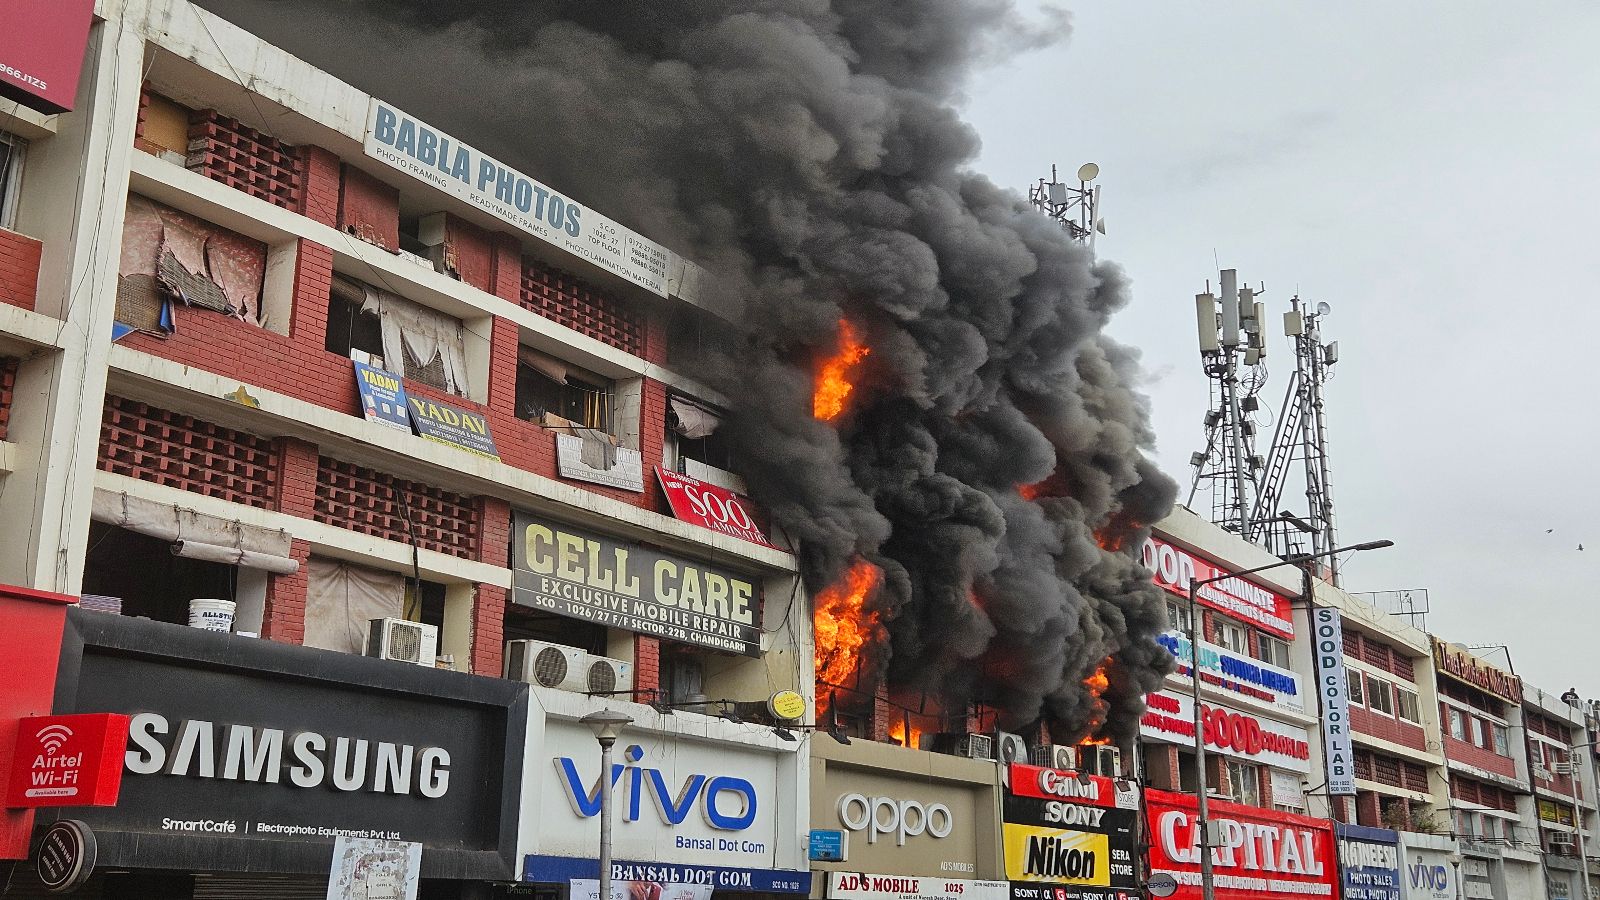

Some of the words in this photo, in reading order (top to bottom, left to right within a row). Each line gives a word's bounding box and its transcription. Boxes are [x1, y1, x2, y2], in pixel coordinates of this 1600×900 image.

[374, 104, 471, 186] BABLA
[477, 156, 582, 239] PHOTOS
[376, 147, 407, 168] PHOTO
[408, 163, 448, 189] FRAMING
[469, 192, 518, 222] READYMADE
[517, 218, 549, 238] FRAMES
[588, 234, 600, 245] TOP
[601, 242, 621, 257] FLOOR
[566, 240, 590, 258] PHOTO
[590, 250, 632, 278] LAMINATION
[632, 272, 663, 293] MATERIAL
[360, 368, 399, 393] YADAV
[408, 398, 487, 436] YADAV
[666, 480, 683, 489] NEW
[525, 524, 640, 598] CELL
[654, 559, 753, 625] CARE
[1142, 537, 1195, 590] OOD
[1211, 567, 1276, 613] LAMINATE
[536, 596, 556, 610] SCO
[567, 602, 609, 622] 1026/27
[612, 615, 629, 628] F/F
[632, 619, 688, 642] SECTOR-22B,
[690, 632, 746, 652] CHANDIGARH
[541, 578, 628, 613] EXCLUSIVE
[633, 602, 689, 627] MOBILE
[693, 616, 742, 640] REPAIR
[1318, 608, 1337, 669] SOOD
[1326, 675, 1341, 735] COLOR
[1201, 704, 1262, 756] SOOD
[1261, 730, 1294, 758] COLOR
[1292, 740, 1310, 760] LAB
[32, 752, 82, 768] Airtel
[125, 711, 451, 799] SAMSUNG
[1332, 740, 1345, 776] LAB
[31, 770, 78, 786] Wi-Fi
[553, 745, 757, 831] vivo
[1041, 769, 1099, 800] Canon
[162, 818, 236, 833] SmartCafé
[256, 822, 316, 836] Electrophoto
[370, 830, 386, 839] Pvt.
[838, 793, 953, 847] oppo
[1046, 801, 1107, 828] SONY
[52, 832, 72, 864] SAMSUNG
[676, 836, 715, 850] Bansal
[718, 839, 738, 852] Dot
[742, 841, 765, 854] Com
[1023, 835, 1096, 879] Nikon
[1112, 848, 1130, 861] SERA
[612, 864, 680, 881] BANSAL
[684, 868, 716, 885] DOT
[772, 880, 781, 889] SCO
[838, 876, 870, 892] ADS
[872, 878, 920, 894] MOBILE
[944, 882, 964, 894] 1025
[1110, 864, 1133, 876] STORE
[1148, 881, 1175, 890] EPSON
[1350, 872, 1370, 884] PHOTO
[1374, 874, 1392, 886] SALES
[1015, 888, 1038, 898] SONY
[1082, 892, 1104, 900] SONY
[1346, 888, 1367, 900] DIGITAL
[1368, 890, 1387, 900] PHOTO
[1388, 890, 1398, 900] LAB
